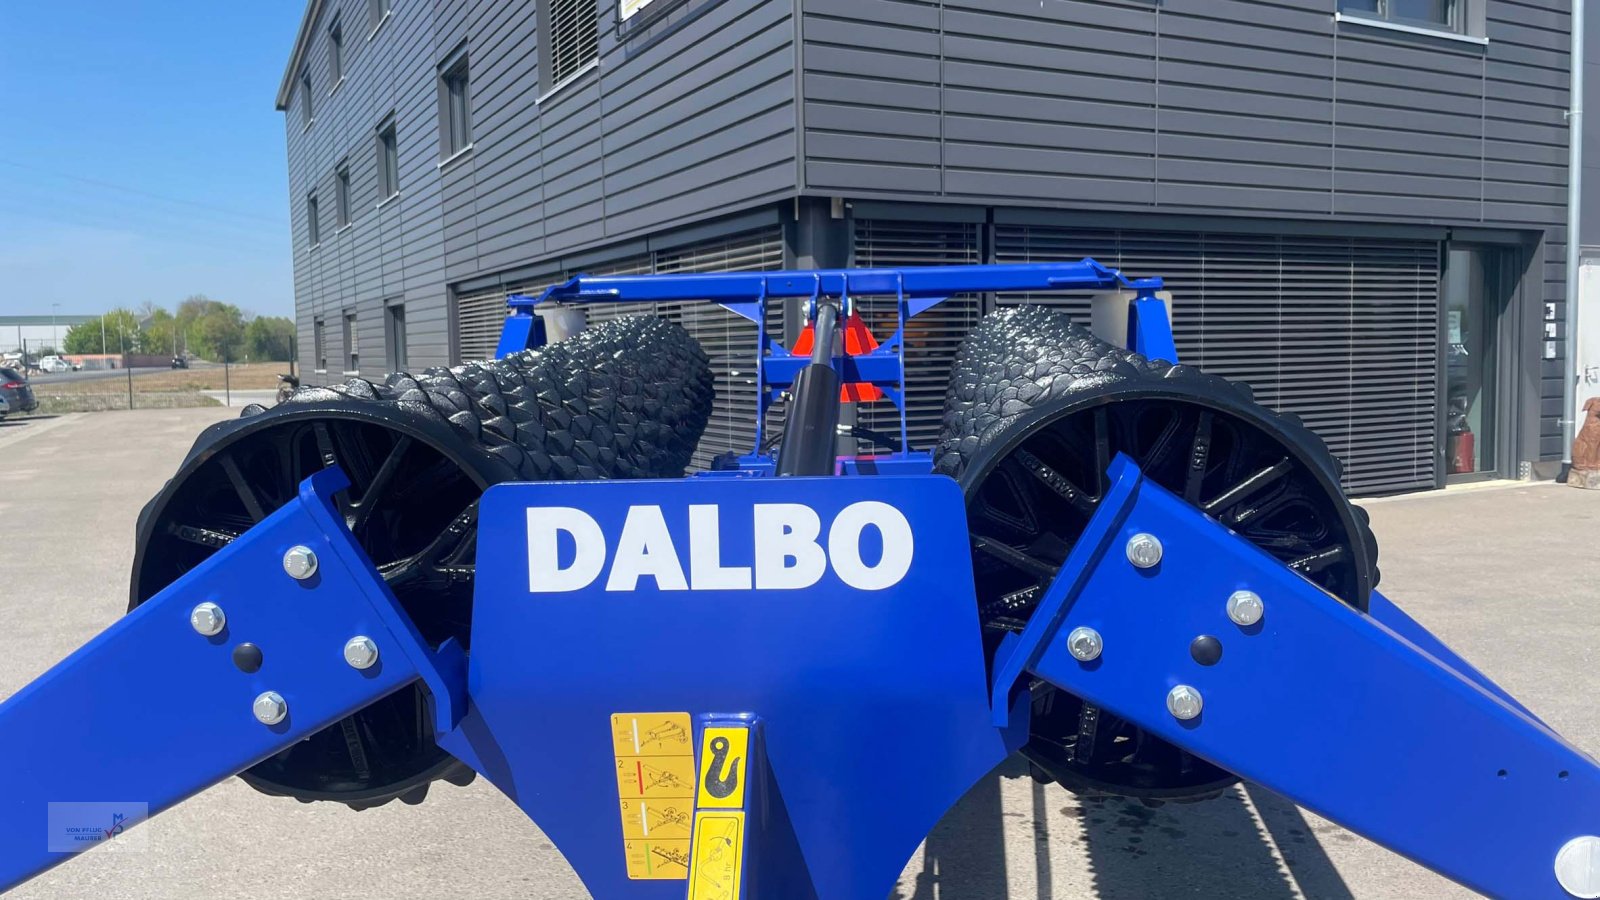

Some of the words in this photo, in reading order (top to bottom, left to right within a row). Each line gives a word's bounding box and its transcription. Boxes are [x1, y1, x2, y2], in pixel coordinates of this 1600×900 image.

[526, 500, 914, 593] DALBO
[614, 717, 618, 725] 1
[618, 760, 624, 768] 2
[622, 801, 629, 810] 3
[626, 842, 632, 850] 4
